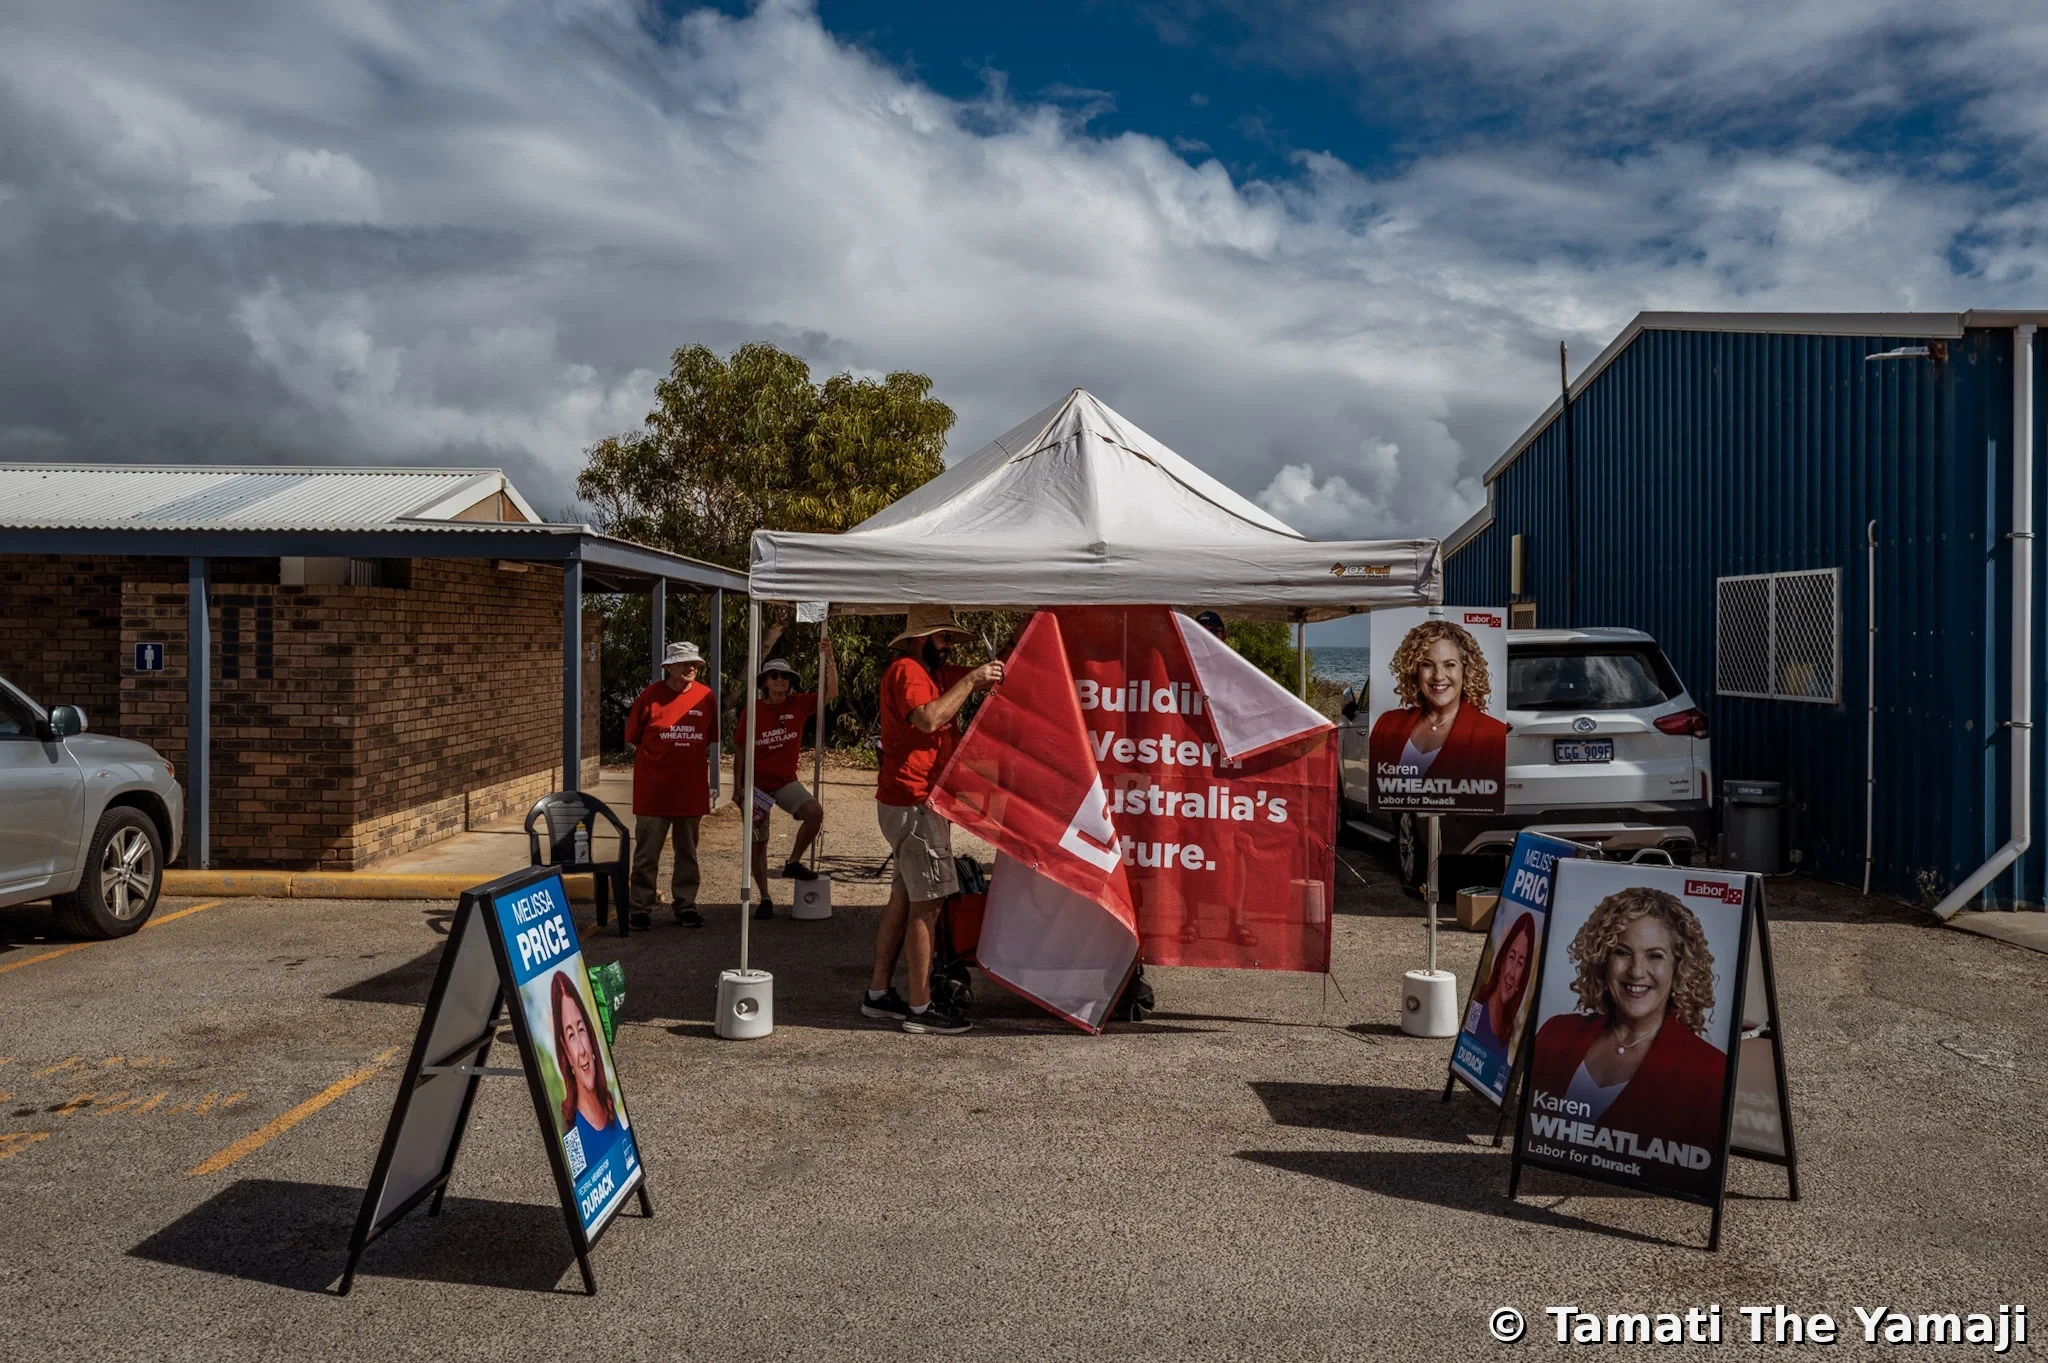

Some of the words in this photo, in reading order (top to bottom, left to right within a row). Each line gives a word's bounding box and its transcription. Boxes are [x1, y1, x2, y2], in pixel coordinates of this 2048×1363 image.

[1466, 614, 1490, 623] Labor
[1075, 679, 1203, 716] Buildi
[670, 725, 696, 733] KAREN
[1377, 762, 1419, 775] Karen
[1377, 777, 1498, 795] WHEATLAND
[1378, 796, 1405, 805] Labor
[1406, 796, 1420, 805] for
[1422, 796, 1456, 806] Durack
[1105, 784, 1288, 824] ustralia's
[1120, 835, 1216, 871] ture.
[1524, 848, 1555, 873] MELISS
[1511, 868, 1549, 907] PRIC
[1688, 882, 1724, 896] Labor
[512, 889, 555, 925] MELISSA
[516, 914, 571, 972] PRICE
[1457, 1046, 1485, 1076] DURACK
[1533, 1089, 1591, 1118] Karen
[1530, 1113, 1712, 1171] WHEATLAND
[1528, 1141, 1566, 1159] Labor
[1569, 1149, 1588, 1164] for
[1591, 1154, 1641, 1177] Durack
[581, 1170, 615, 1220] DURACK
